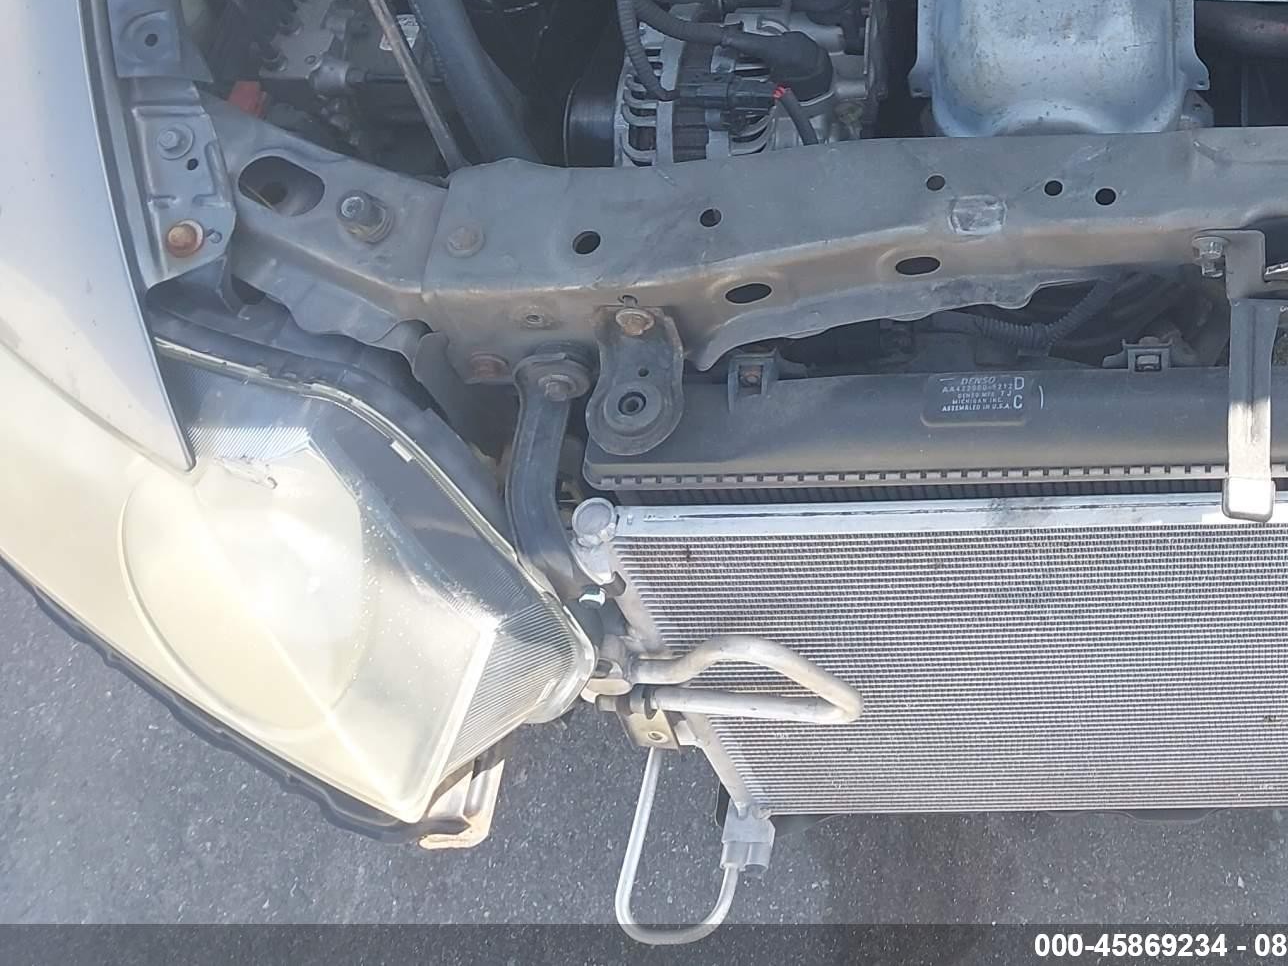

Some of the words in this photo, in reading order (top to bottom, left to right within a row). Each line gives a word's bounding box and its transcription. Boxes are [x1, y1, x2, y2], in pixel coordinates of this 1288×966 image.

[960, 376, 996, 385] DENSO
[1014, 376, 1025, 390] D
[1013, 394, 1023, 409] C
